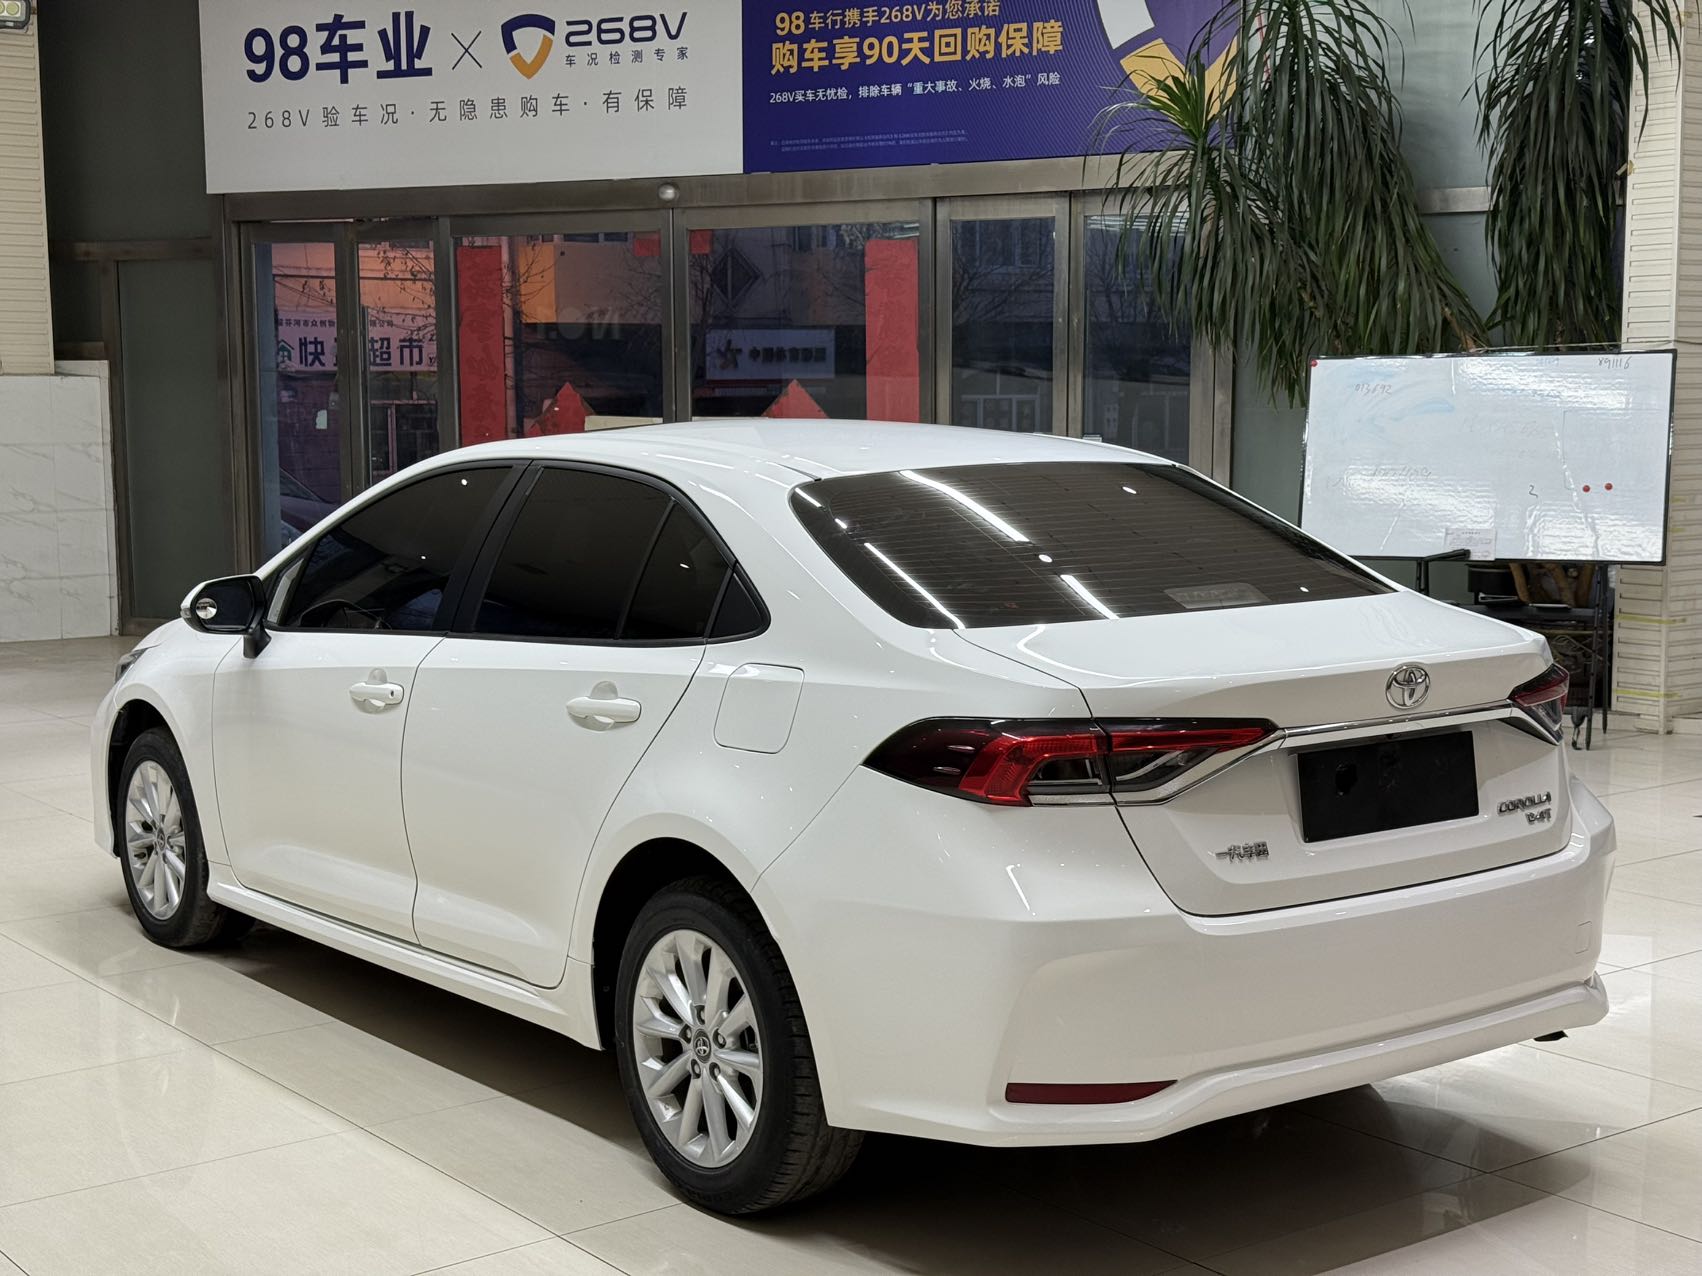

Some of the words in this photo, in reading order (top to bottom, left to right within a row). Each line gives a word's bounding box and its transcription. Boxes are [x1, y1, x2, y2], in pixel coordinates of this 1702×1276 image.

[565, 11, 688, 47] 268V
[770, 19, 1064, 75] 购车享90天回购保障
[243, 10, 433, 85] 98车业
[565, 46, 689, 68] 车况检测专家
[1497, 791, 1552, 816] COROLLA
